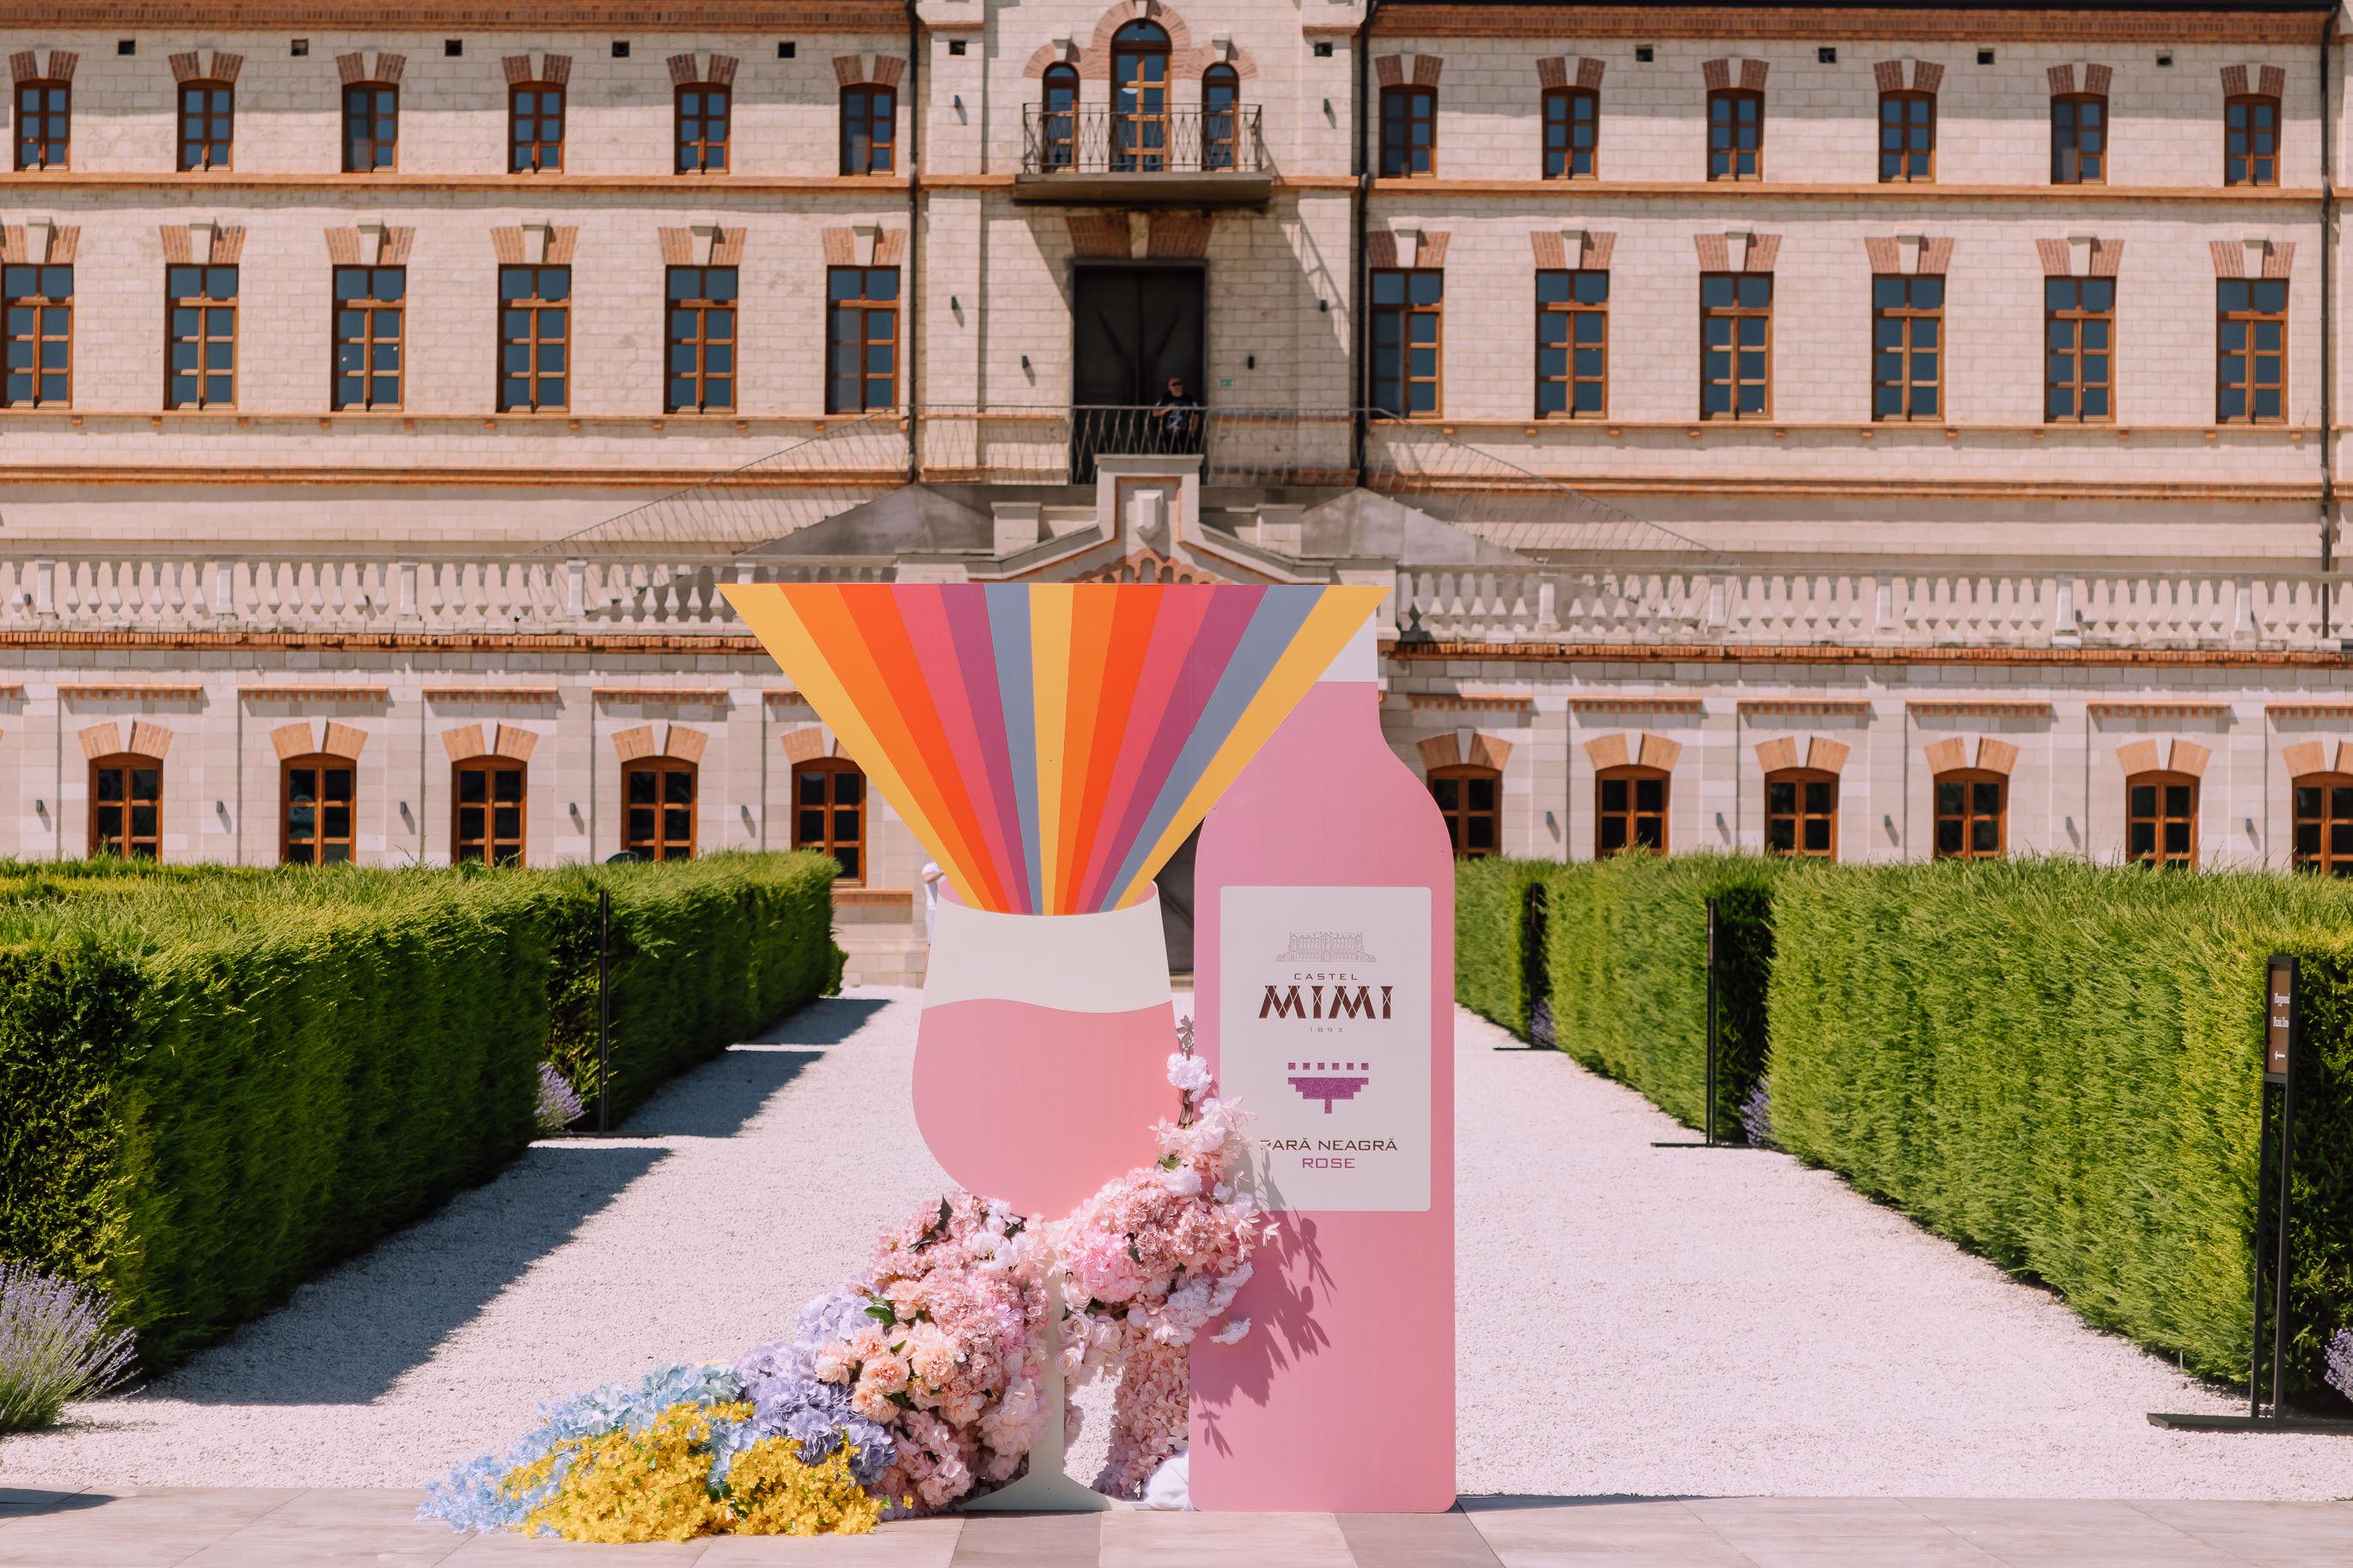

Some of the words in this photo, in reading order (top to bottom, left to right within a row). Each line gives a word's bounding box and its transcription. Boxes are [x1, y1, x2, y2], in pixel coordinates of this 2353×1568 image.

[1258, 985, 1394, 1019] MIMI
[1318, 1138, 1398, 1150] NEAGRĂ
[1302, 1158, 1356, 1168] ROSE
